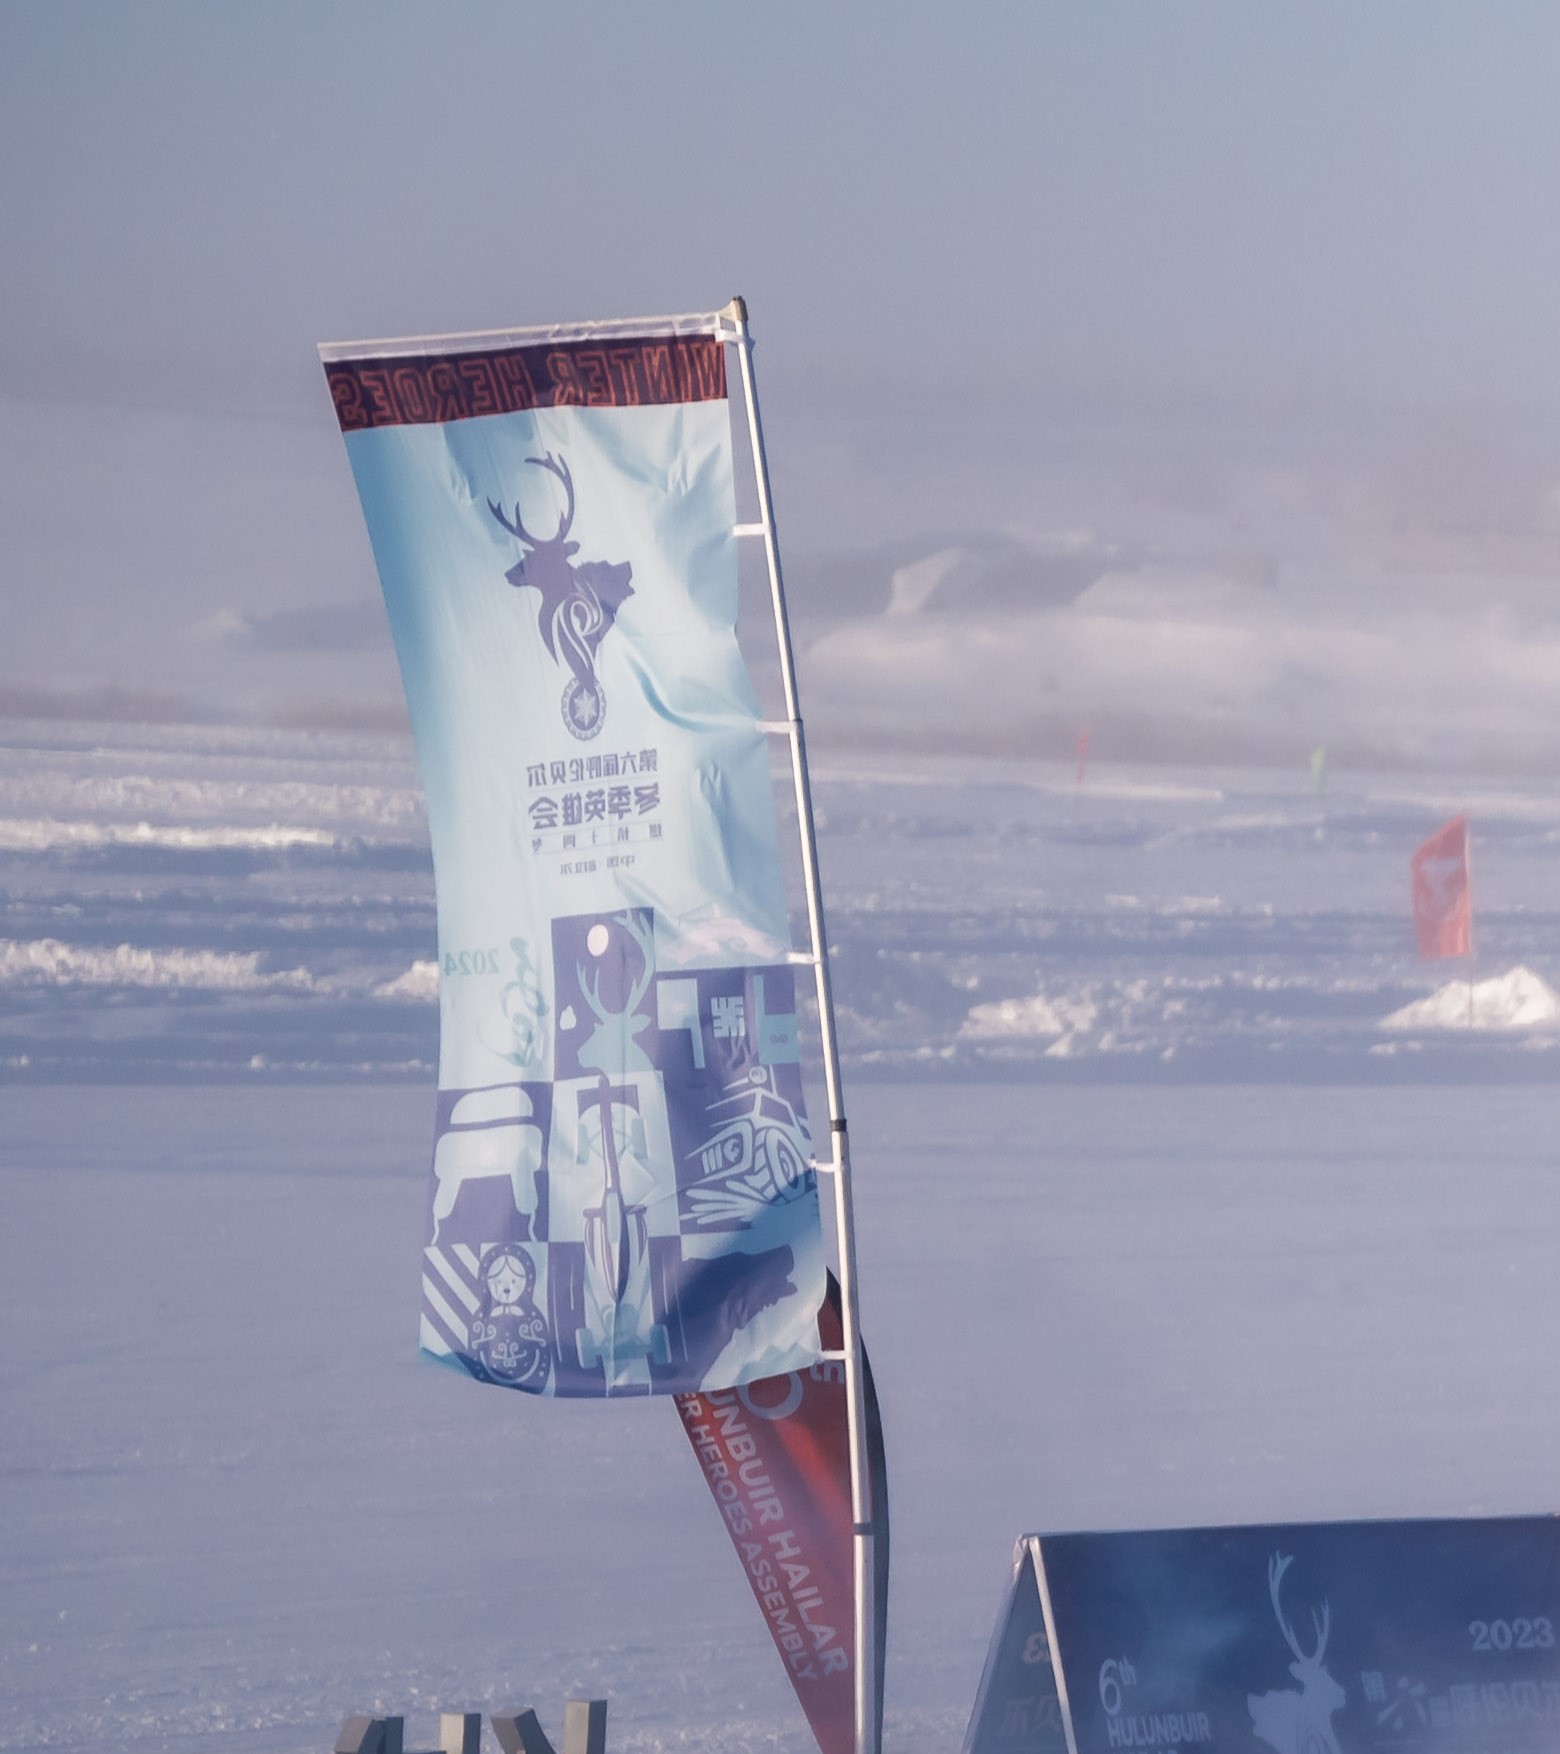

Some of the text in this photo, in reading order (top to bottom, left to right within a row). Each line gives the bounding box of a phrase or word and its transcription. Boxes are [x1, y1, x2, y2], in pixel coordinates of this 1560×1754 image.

[691, 1423, 819, 1682] HEROES ASSEMBLY
[767, 1529, 849, 1677] HAILAR
[1468, 1616, 1556, 1652] 2023
[1105, 1711, 1212, 1748] HULUNBUIR
